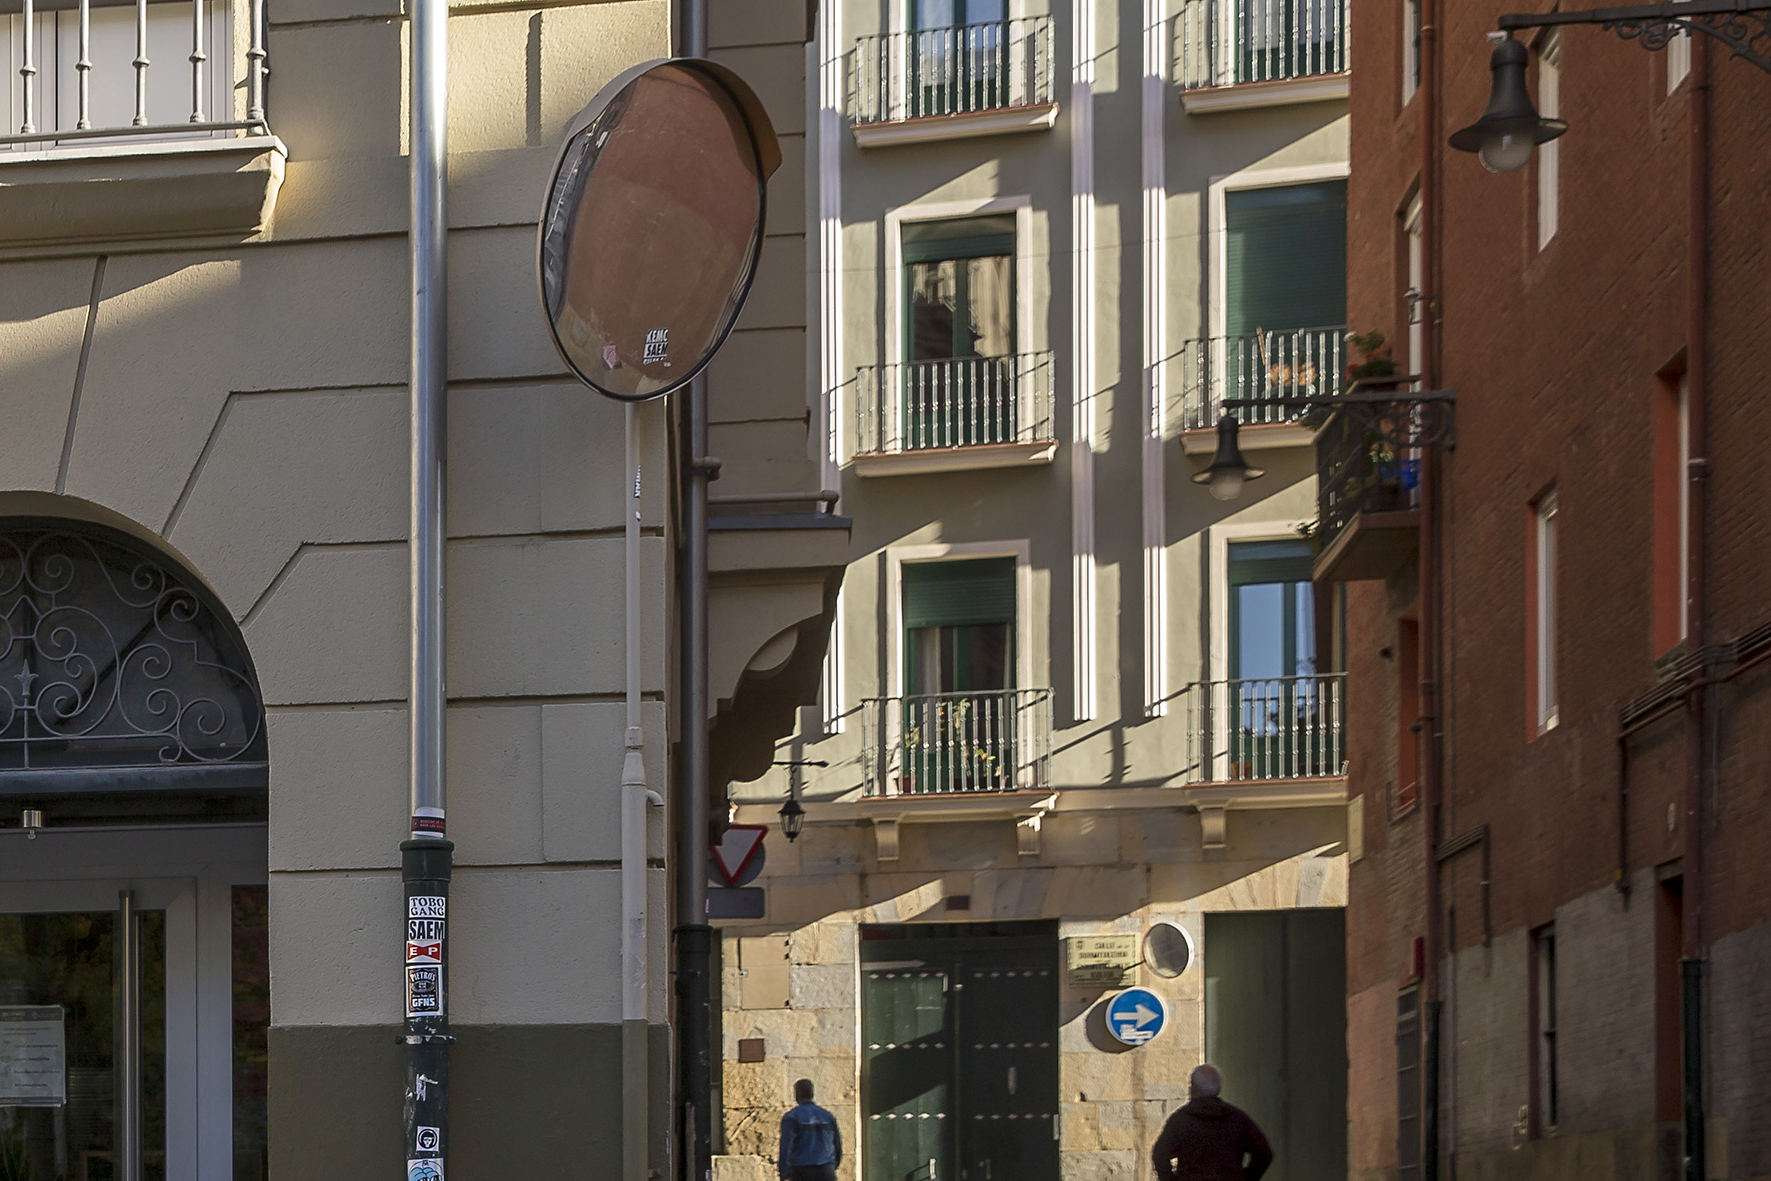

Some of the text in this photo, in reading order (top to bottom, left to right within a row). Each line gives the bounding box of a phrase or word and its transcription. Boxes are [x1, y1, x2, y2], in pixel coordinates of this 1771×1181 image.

[410, 897, 445, 907] TOBO
[410, 907, 445, 916] GANG
[409, 920, 445, 940] SAEM
[410, 947, 438, 956] E P
